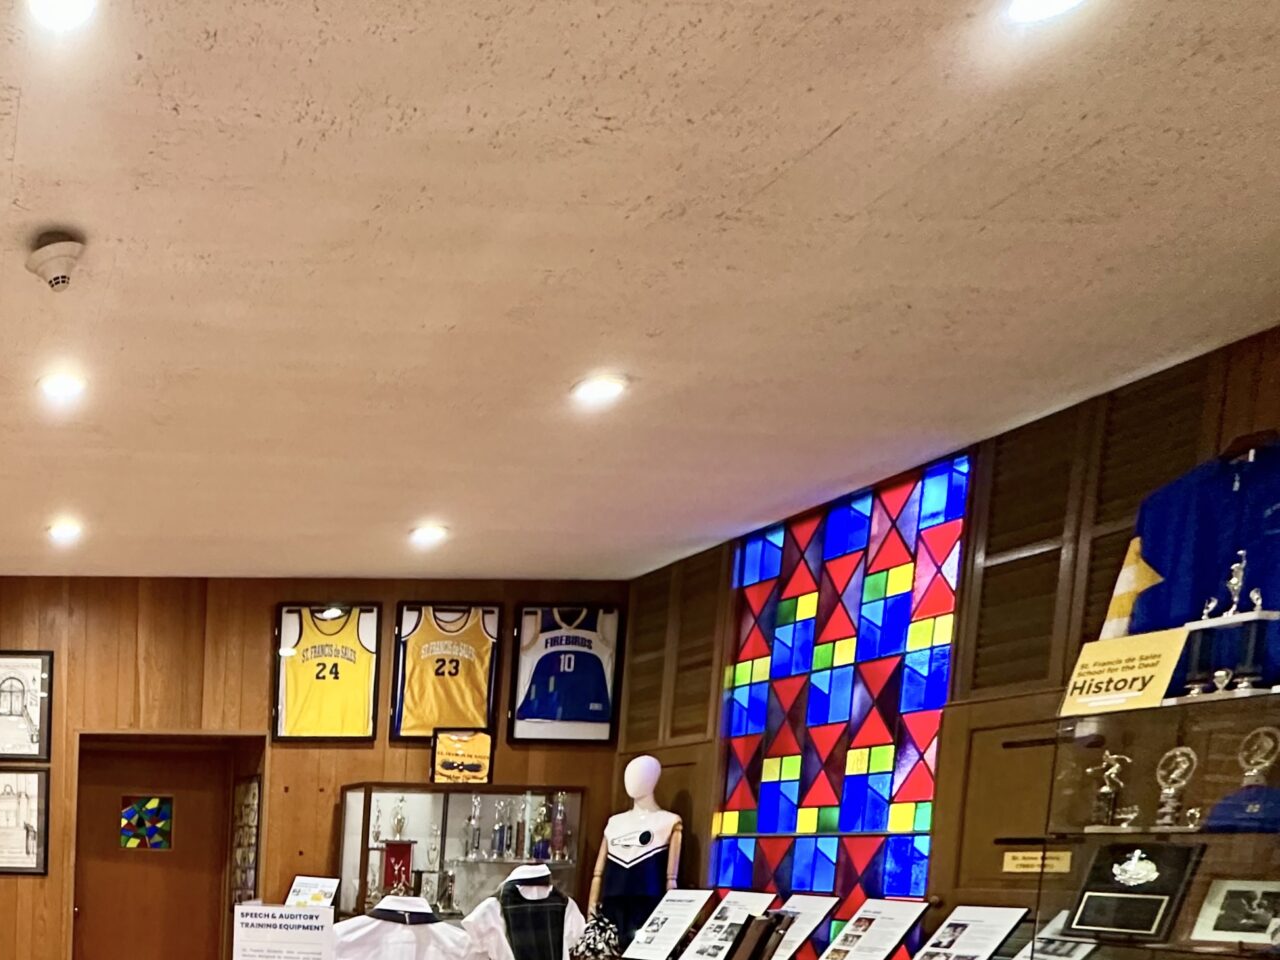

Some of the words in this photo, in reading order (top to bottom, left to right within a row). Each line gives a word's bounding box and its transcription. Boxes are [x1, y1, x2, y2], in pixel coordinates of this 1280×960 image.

[545, 635, 593, 650] FIREBIRDS
[315, 662, 340, 680] 24
[434, 658, 460, 677] 23
[560, 654, 575, 672] 10
[1121, 664, 1136, 672] the
[1070, 675, 1155, 696] History
[240, 912, 270, 920] SPEECH
[279, 913, 320, 921] AUDITORY
[240, 922, 278, 930] TRAINING
[278, 924, 325, 932] EQUIPMENT
